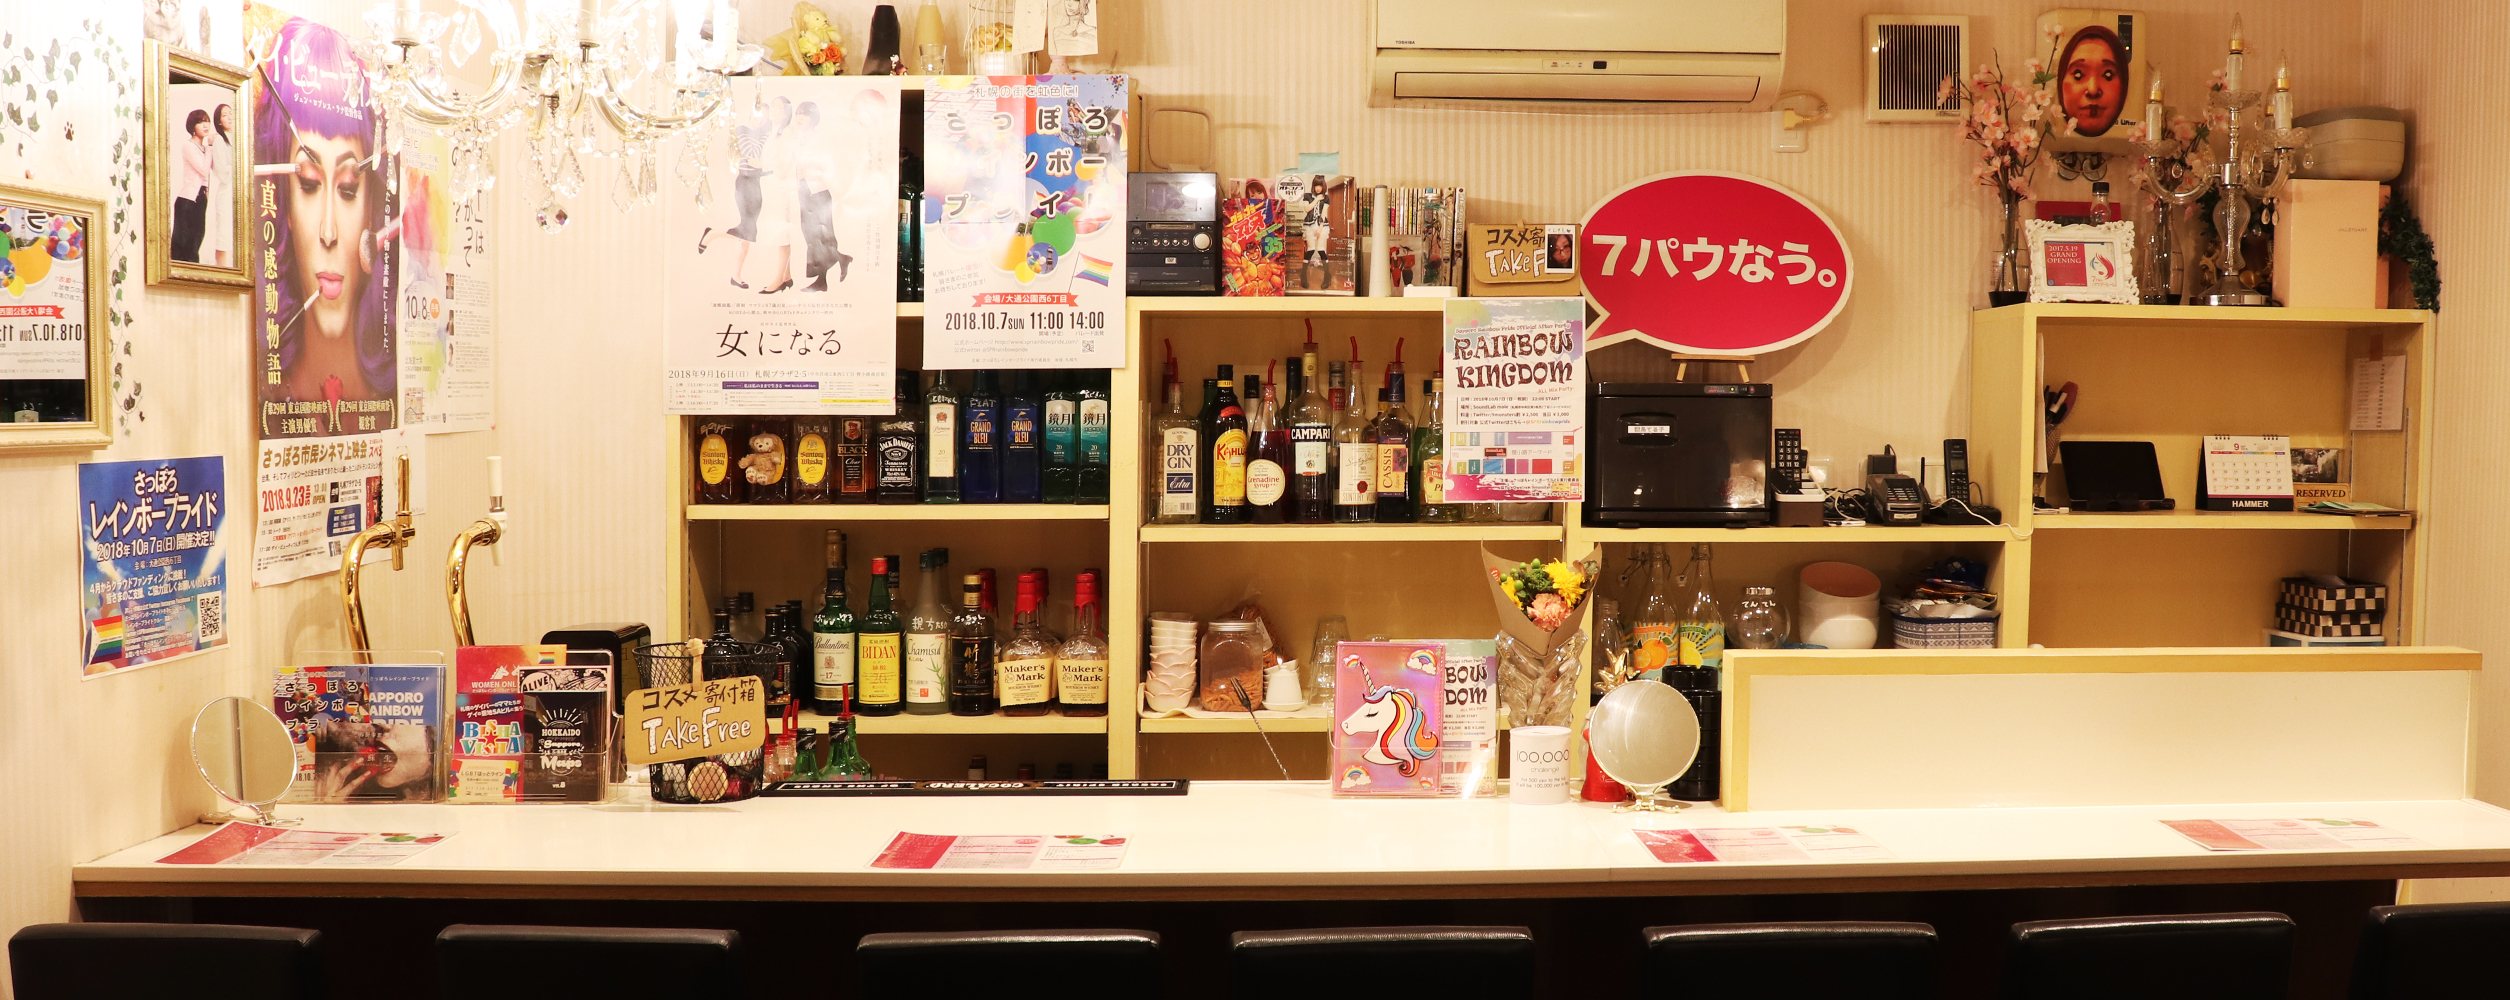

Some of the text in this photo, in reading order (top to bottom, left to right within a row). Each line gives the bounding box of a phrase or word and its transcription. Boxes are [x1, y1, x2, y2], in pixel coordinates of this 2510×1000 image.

[974, 84, 1079, 98] 札幌の街を虹色に!
[946, 106, 1110, 135] さっぽろ
[1487, 226, 1545, 248] コスメ寄
[1264, 236, 1283, 253] 35
[1592, 234, 1837, 289] 7パウなう。
[260, 180, 282, 385] 真の感動物語
[984, 294, 1068, 304] 会場/大通公園西6丁目
[1030, 311, 1064, 330] 11:00
[1069, 311, 1105, 330] 14:00
[716, 323, 842, 358] 女になる
[1453, 330, 1573, 361] RAINBOW
[668, 369, 749, 379] 2018年9月16日(日)
[1455, 360, 1573, 389] KINGDOM
[268, 400, 328, 415] 第29回 東京国際映画祭
[340, 399, 391, 414] 第29回 東京国際映画祭
[358, 415, 376, 430] 観客賞
[1048, 413, 1071, 425] 鏡月
[1083, 413, 1106, 425] 鏡月
[281, 418, 317, 434] 主演男優賞
[970, 421, 991, 432] GRAND
[1011, 420, 1033, 432] GRAND
[973, 433, 988, 444] BLEU
[1014, 432, 1029, 443] BLEU
[1291, 427, 1331, 440] CAMPARI
[838, 446, 868, 455] BLACK
[879, 439, 893, 452] JACK
[1167, 445, 1194, 456] DRY
[2233, 442, 2240, 451] 9
[263, 440, 368, 469] さっぽろ市民シネマ上映会
[1167, 457, 1192, 468] GIN
[1382, 448, 1393, 489] CASSIS
[134, 468, 178, 495] さっぽろ
[1169, 476, 1191, 489] Extra
[262, 486, 305, 513] 2018.9.23
[312, 494, 326, 505] OPEN
[2296, 489, 2346, 498] RESERVED
[2232, 500, 2269, 508] HAMMER
[90, 492, 218, 540] レインボープライド
[862, 645, 897, 659] BIDAN
[1004, 664, 1046, 673] Maker's
[1062, 665, 1104, 673] Maker's
[1016, 673, 1046, 681] Mark
[1073, 674, 1104, 682] Mark
[285, 679, 359, 693] さっぽろ
[471, 681, 500, 689] WOMEN
[369, 691, 424, 704] APPORO
[642, 678, 758, 712] コスメ 寄付箱
[285, 699, 359, 713] レインボー
[369, 704, 424, 717] AINBOW
[541, 728, 581, 737] HOKKAIDO
[540, 755, 583, 771] Maps
